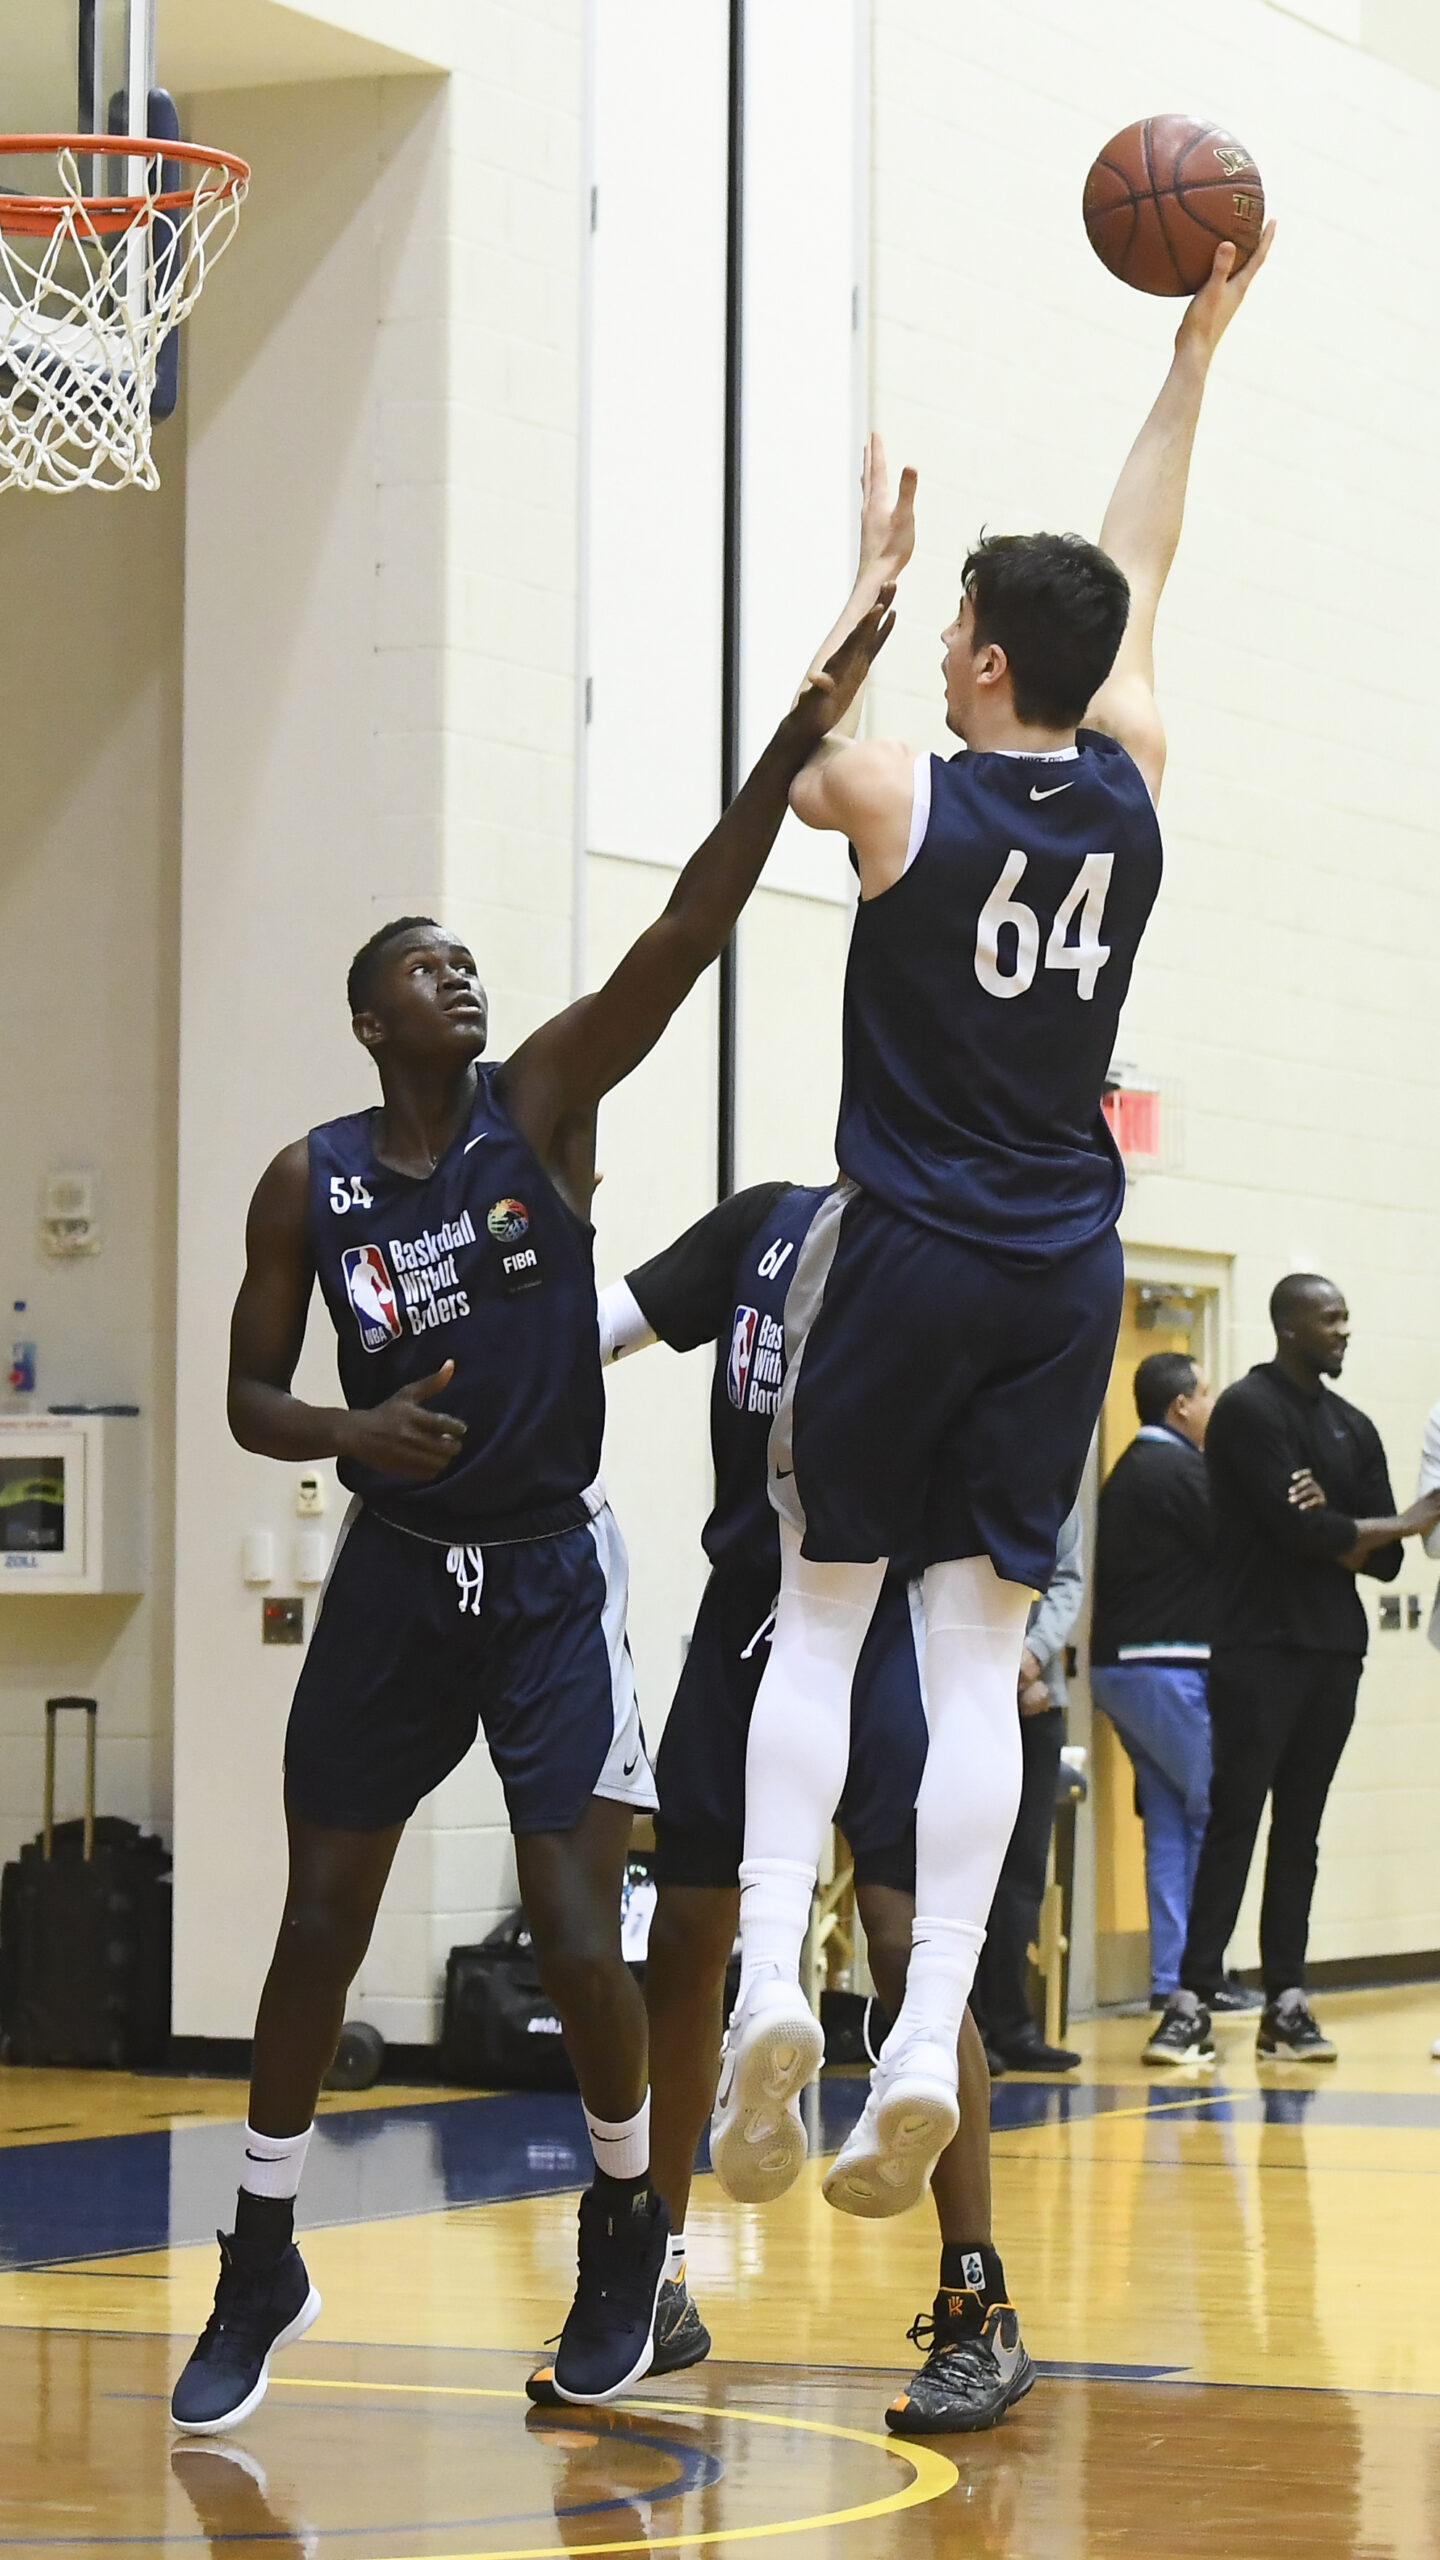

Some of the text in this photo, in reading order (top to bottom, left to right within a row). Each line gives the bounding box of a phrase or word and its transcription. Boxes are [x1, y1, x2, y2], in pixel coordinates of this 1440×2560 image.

[974, 849, 1115, 1001] 64
[329, 1176, 374, 1215] 54
[388, 1209, 477, 1273] Baskball
[502, 1249, 538, 1274] FIBA
[757, 1237, 794, 1280] 61
[406, 1290, 471, 1336] Bders
[364, 1325, 387, 1346] NBA
